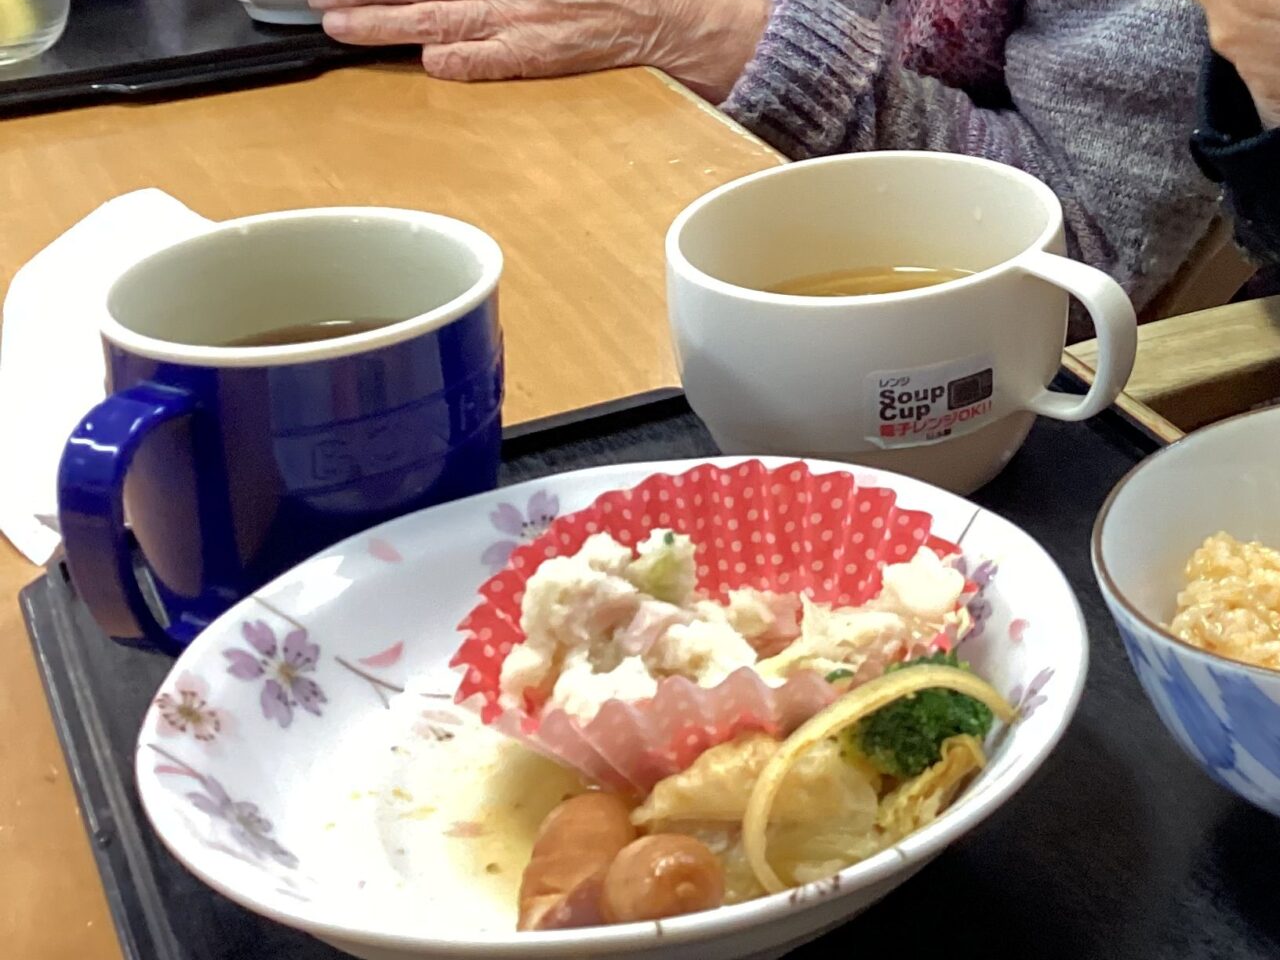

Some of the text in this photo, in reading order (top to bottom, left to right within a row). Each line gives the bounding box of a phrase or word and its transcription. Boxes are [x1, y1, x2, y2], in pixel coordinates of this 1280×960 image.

[879, 376, 910, 388] レンジ
[879, 386, 945, 405] Soup
[879, 404, 931, 421] Cup
